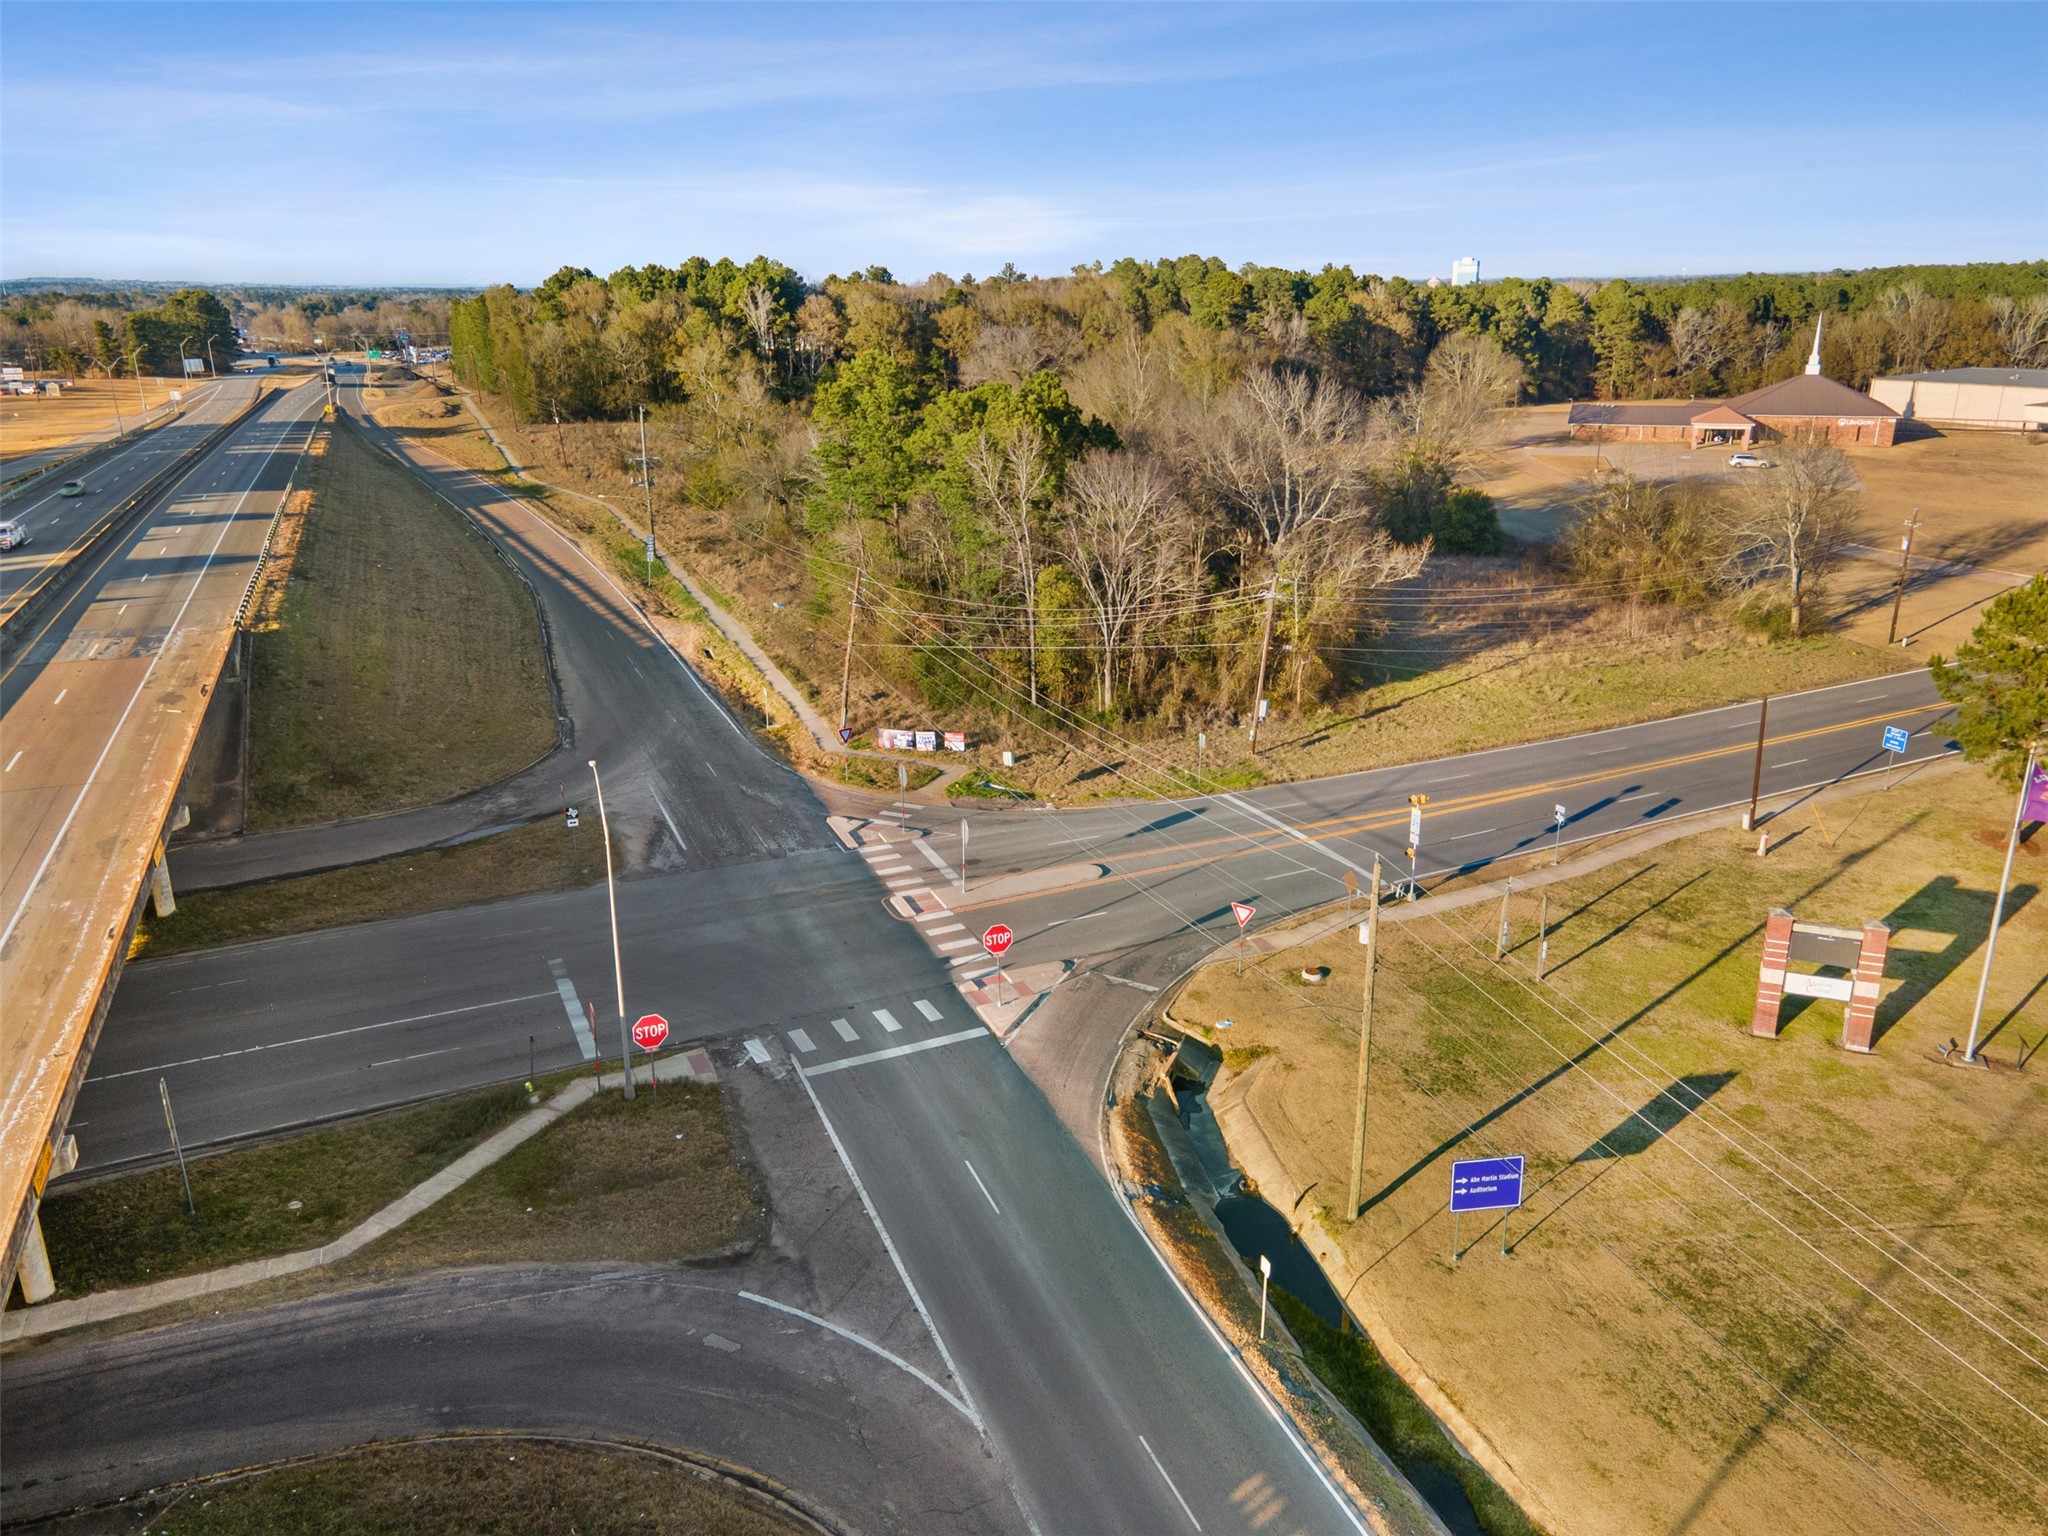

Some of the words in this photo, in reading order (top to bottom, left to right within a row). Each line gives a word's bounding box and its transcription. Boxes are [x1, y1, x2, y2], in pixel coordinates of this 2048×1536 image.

[985, 932, 1011, 946] STOP
[635, 1023, 665, 1040] STOP
[1498, 1173, 1519, 1181] Stadium
[1469, 1186, 1498, 1194] Auditorium
